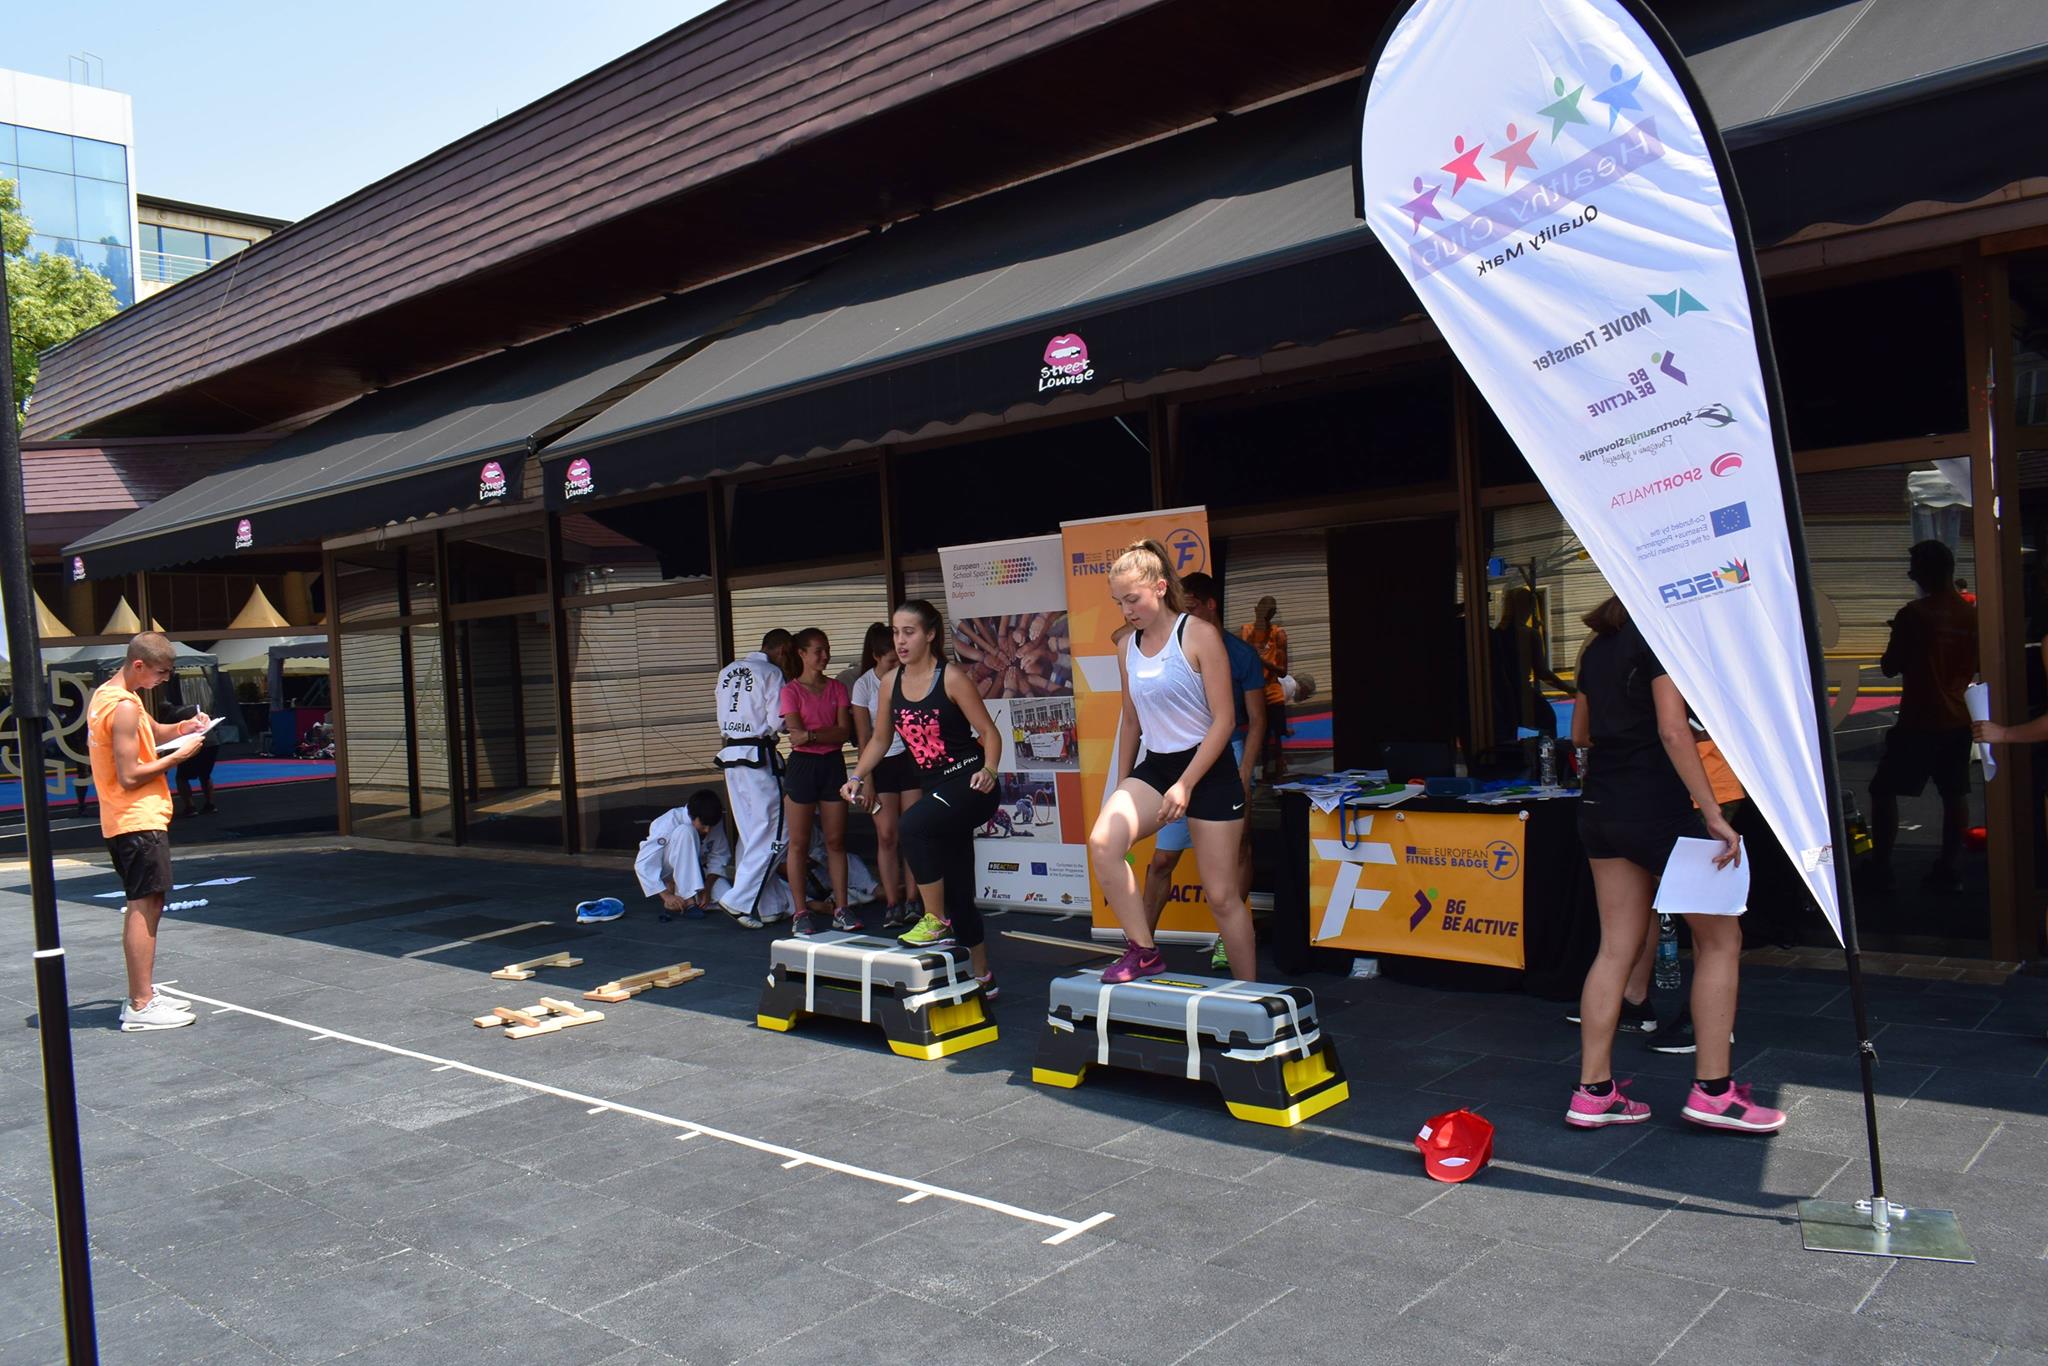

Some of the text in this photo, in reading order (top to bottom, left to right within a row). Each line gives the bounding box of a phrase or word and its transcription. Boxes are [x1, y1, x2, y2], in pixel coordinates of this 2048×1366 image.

[1041, 359, 1090, 378] Street
[1039, 369, 1094, 392] Lounge
[953, 562, 980, 571] European
[1073, 562, 1112, 576] FITNES
[953, 570, 989, 580] School Sport
[1434, 847, 1488, 859] EUROPEAN
[1406, 855, 1488, 869] FITNESS BADGE
[1445, 899, 1466, 915] BG
[1442, 916, 1519, 937] BE ACTIVE
